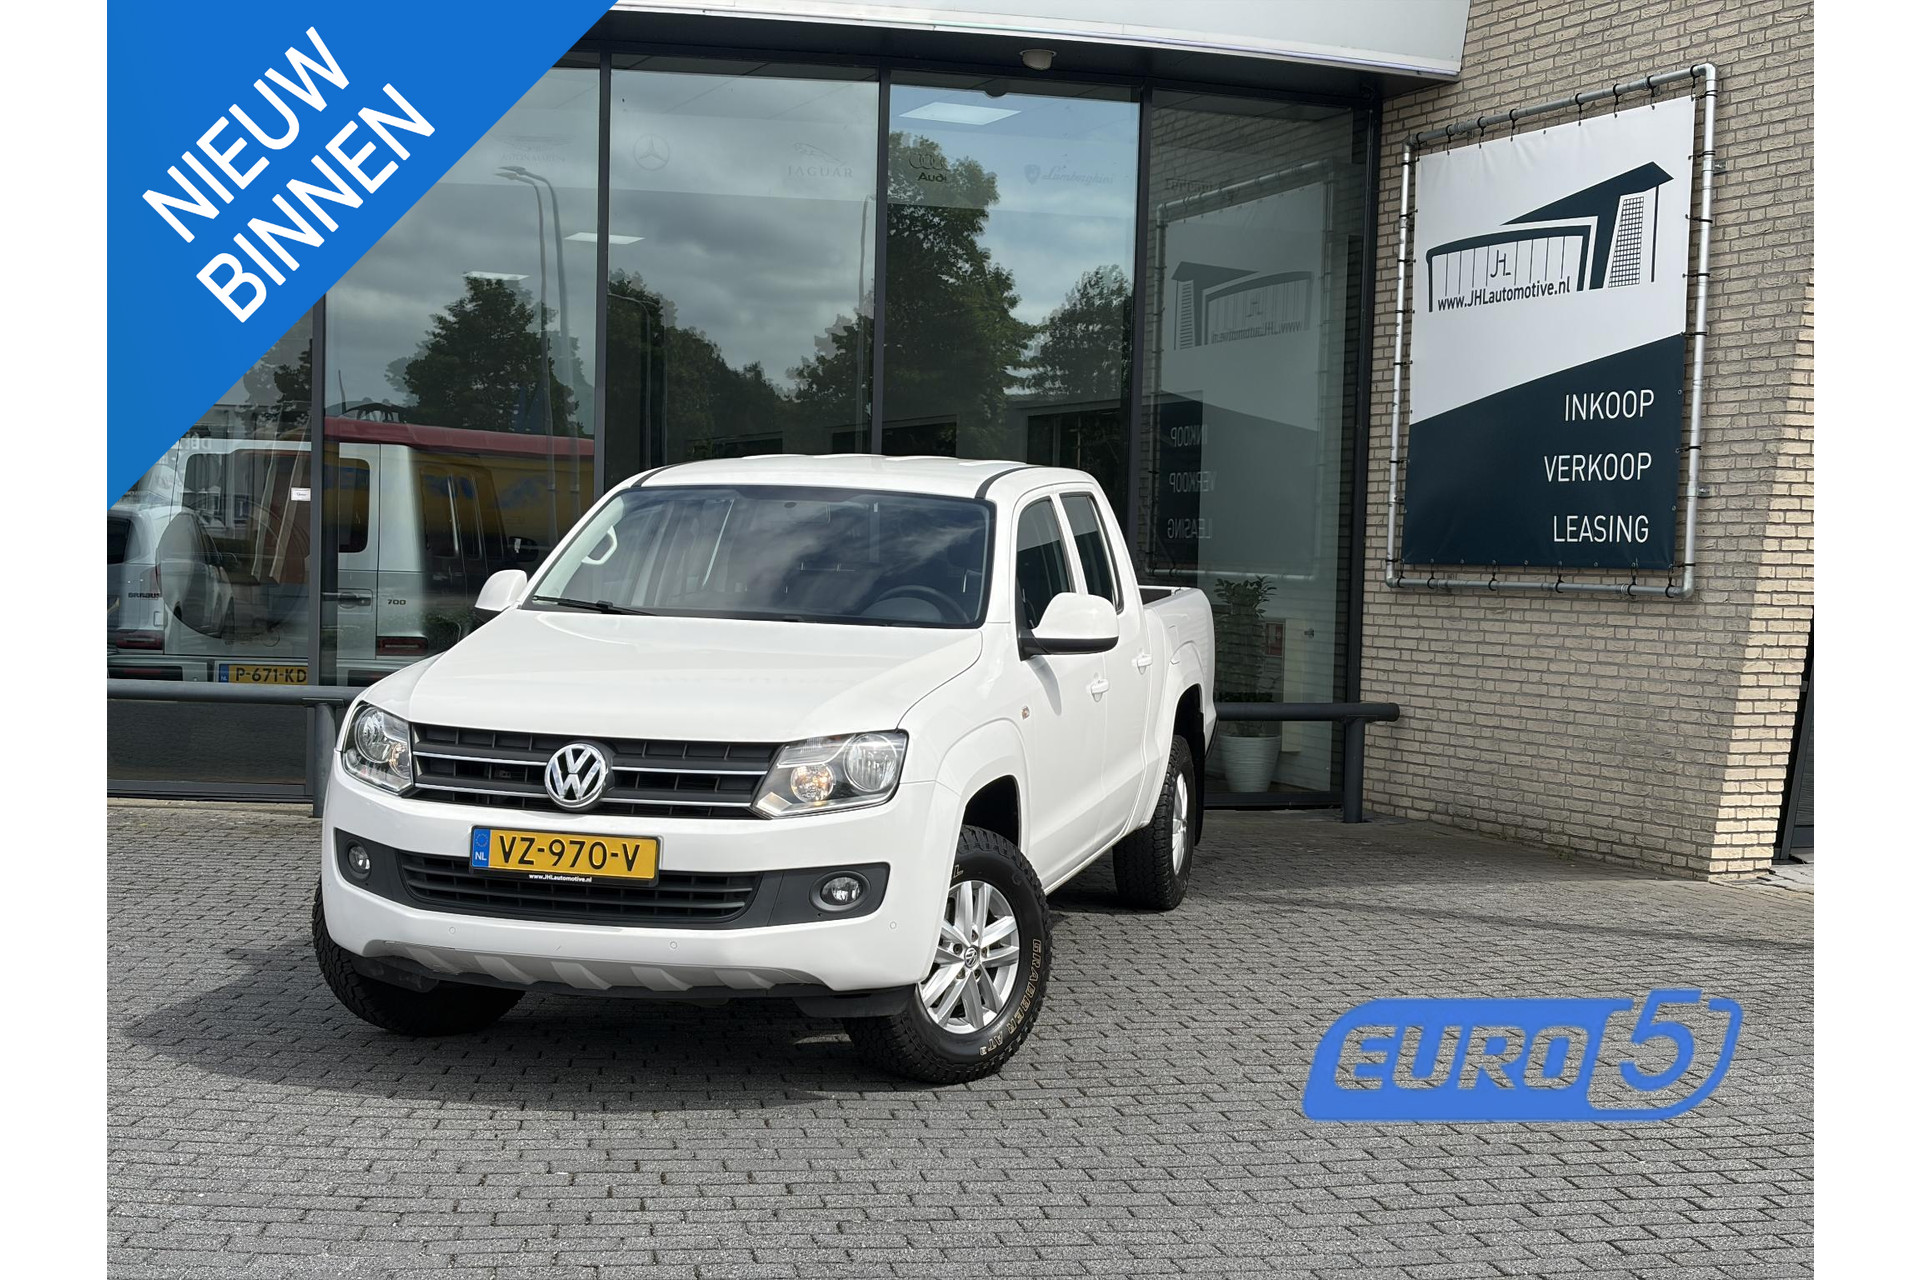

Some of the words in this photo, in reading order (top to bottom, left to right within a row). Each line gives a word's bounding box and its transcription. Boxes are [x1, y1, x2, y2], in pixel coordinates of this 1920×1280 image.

[788, 165, 854, 178] JAGUAR
[917, 172, 948, 183] Audi
[1438, 276, 1571, 312] www.JHLautomotive.nl
[1564, 389, 1655, 422] INKOOP
[1544, 452, 1653, 483] VERKOOP
[1553, 515, 1650, 544] LEASING
[235, 667, 307, 684] P-671-KD
[475, 851, 487, 861] NL
[499, 835, 641, 872] VZ-970-V
[529, 873, 593, 883] www.JHLautomotive.nl
